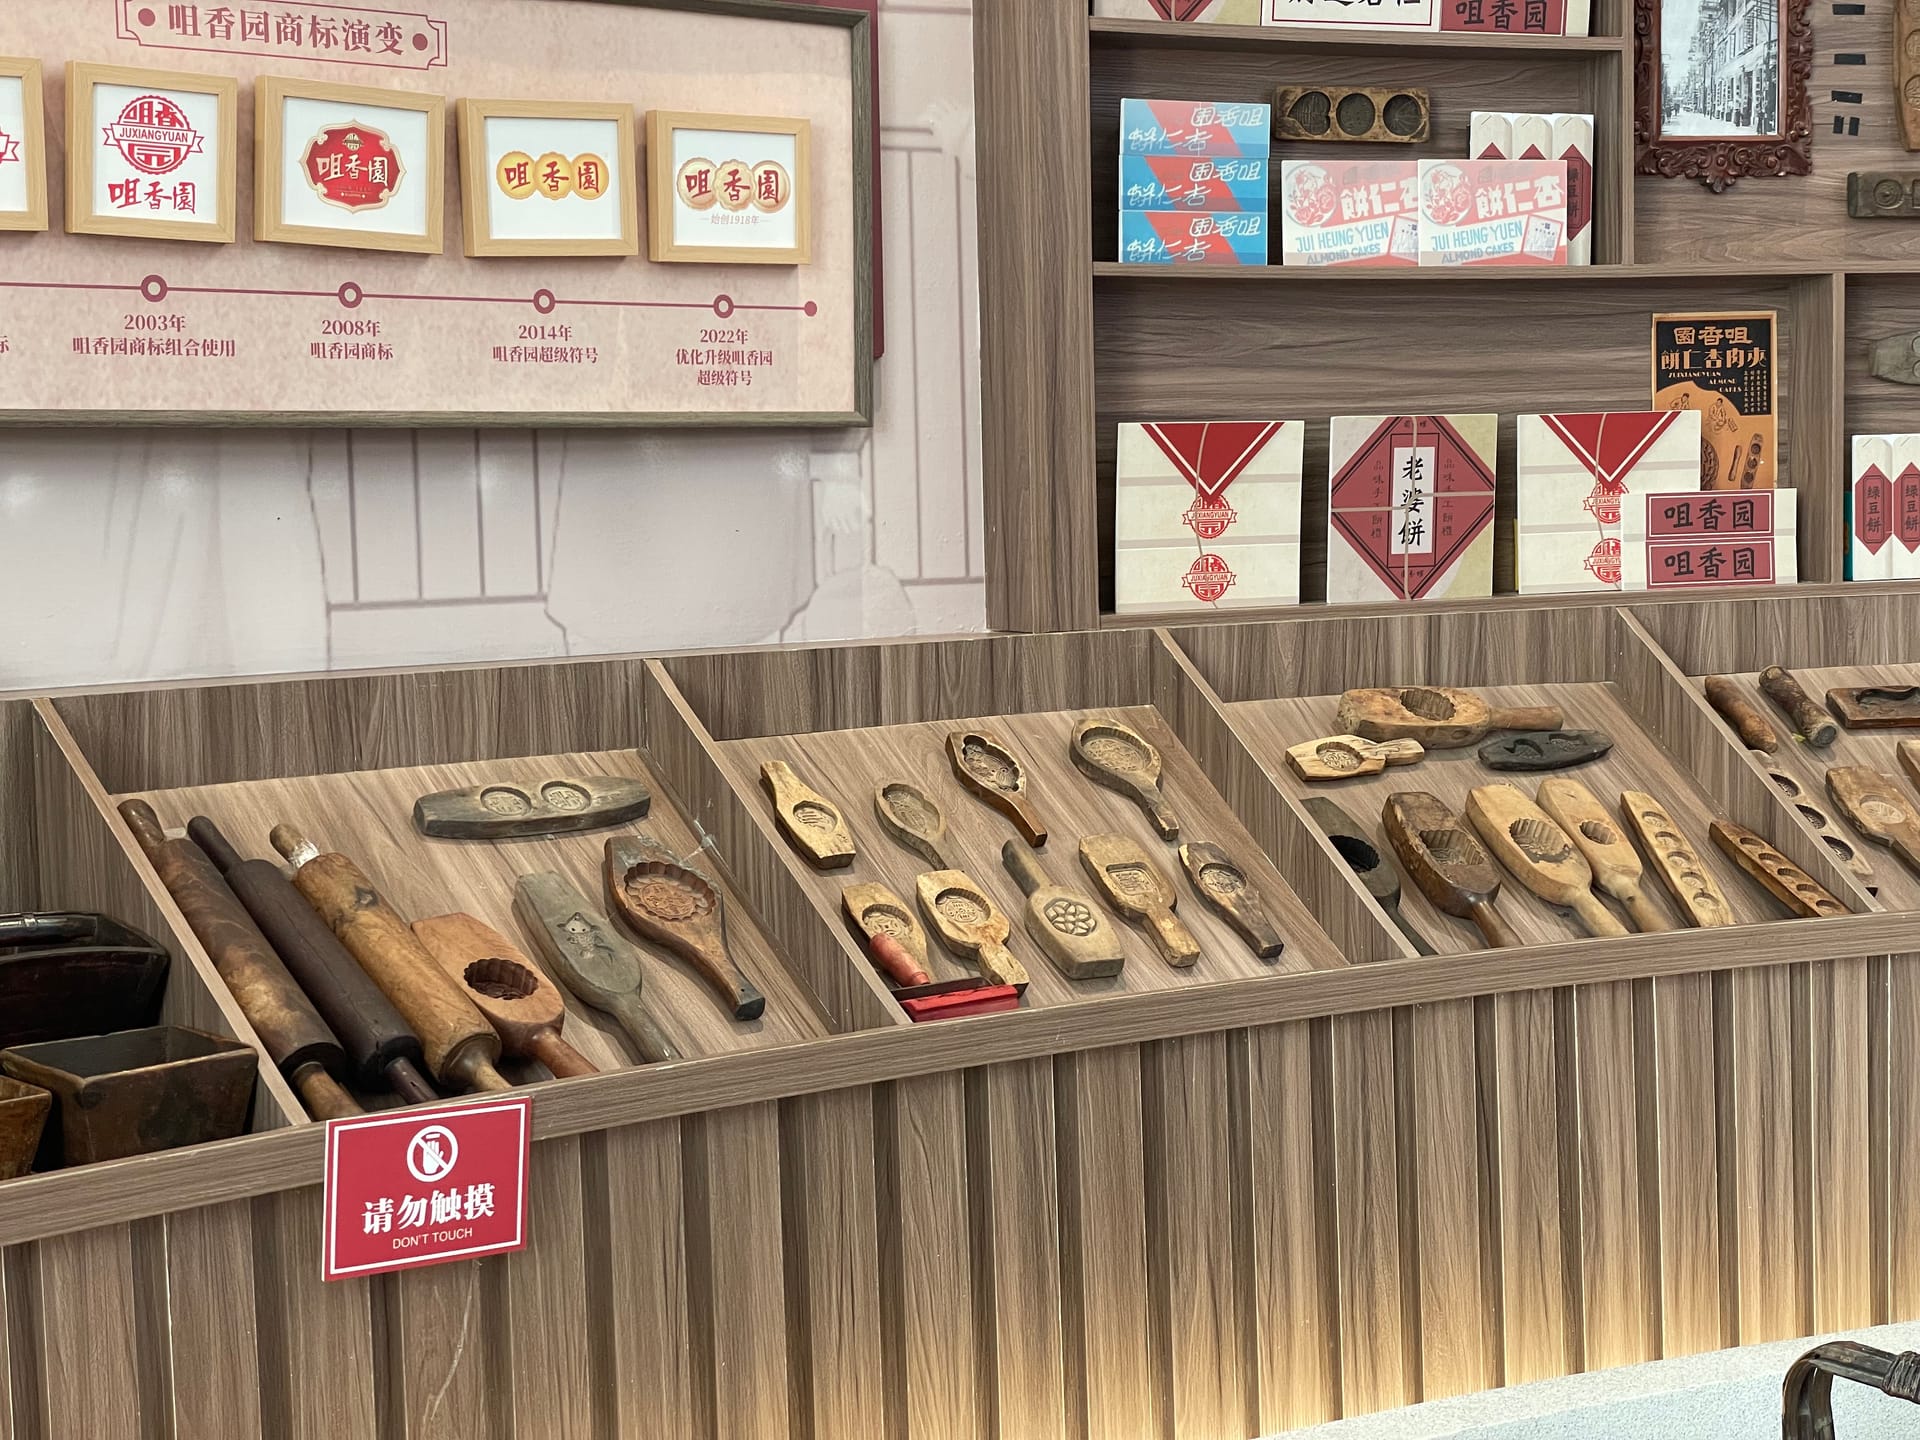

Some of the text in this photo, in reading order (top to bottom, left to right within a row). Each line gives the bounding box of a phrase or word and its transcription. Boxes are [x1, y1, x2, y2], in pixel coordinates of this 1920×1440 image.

[168, 4, 404, 56] 咀香园商标演变
[120, 128, 188, 143] JUXIANGYUAN
[316, 153, 388, 187] 咀香園
[504, 161, 600, 194] 咀香園
[108, 178, 196, 214] 咀香園
[685, 168, 780, 204] 咀香園
[1296, 235, 1314, 253] JUI
[1318, 228, 1354, 249] HEUNG
[1355, 221, 1389, 242] YUEN
[1431, 235, 1449, 251] JUI
[1453, 227, 1488, 248] HEUNG
[1490, 220, 1522, 240] YUEN
[1306, 243, 1380, 264] ALMOND CAKES
[1441, 242, 1514, 264] ALMOND CAKES
[124, 314, 186, 332] 2003年
[322, 319, 381, 337] 2008年
[518, 324, 572, 341] 2014年
[72, 336, 236, 357] 咀香园商标组合使用
[700, 328, 749, 345] 2022年
[310, 342, 394, 361] 咀香园商标
[492, 346, 598, 364] 咀香园超级符号
[676, 349, 773, 366] 优化升级咀香园
[697, 370, 752, 386] 超级符号
[1664, 499, 1754, 530] 咀香园
[1664, 548, 1755, 578] 咀香园
[362, 1183, 496, 1234] 请勿触摸
[392, 1228, 473, 1249] DON'T TOUCH
